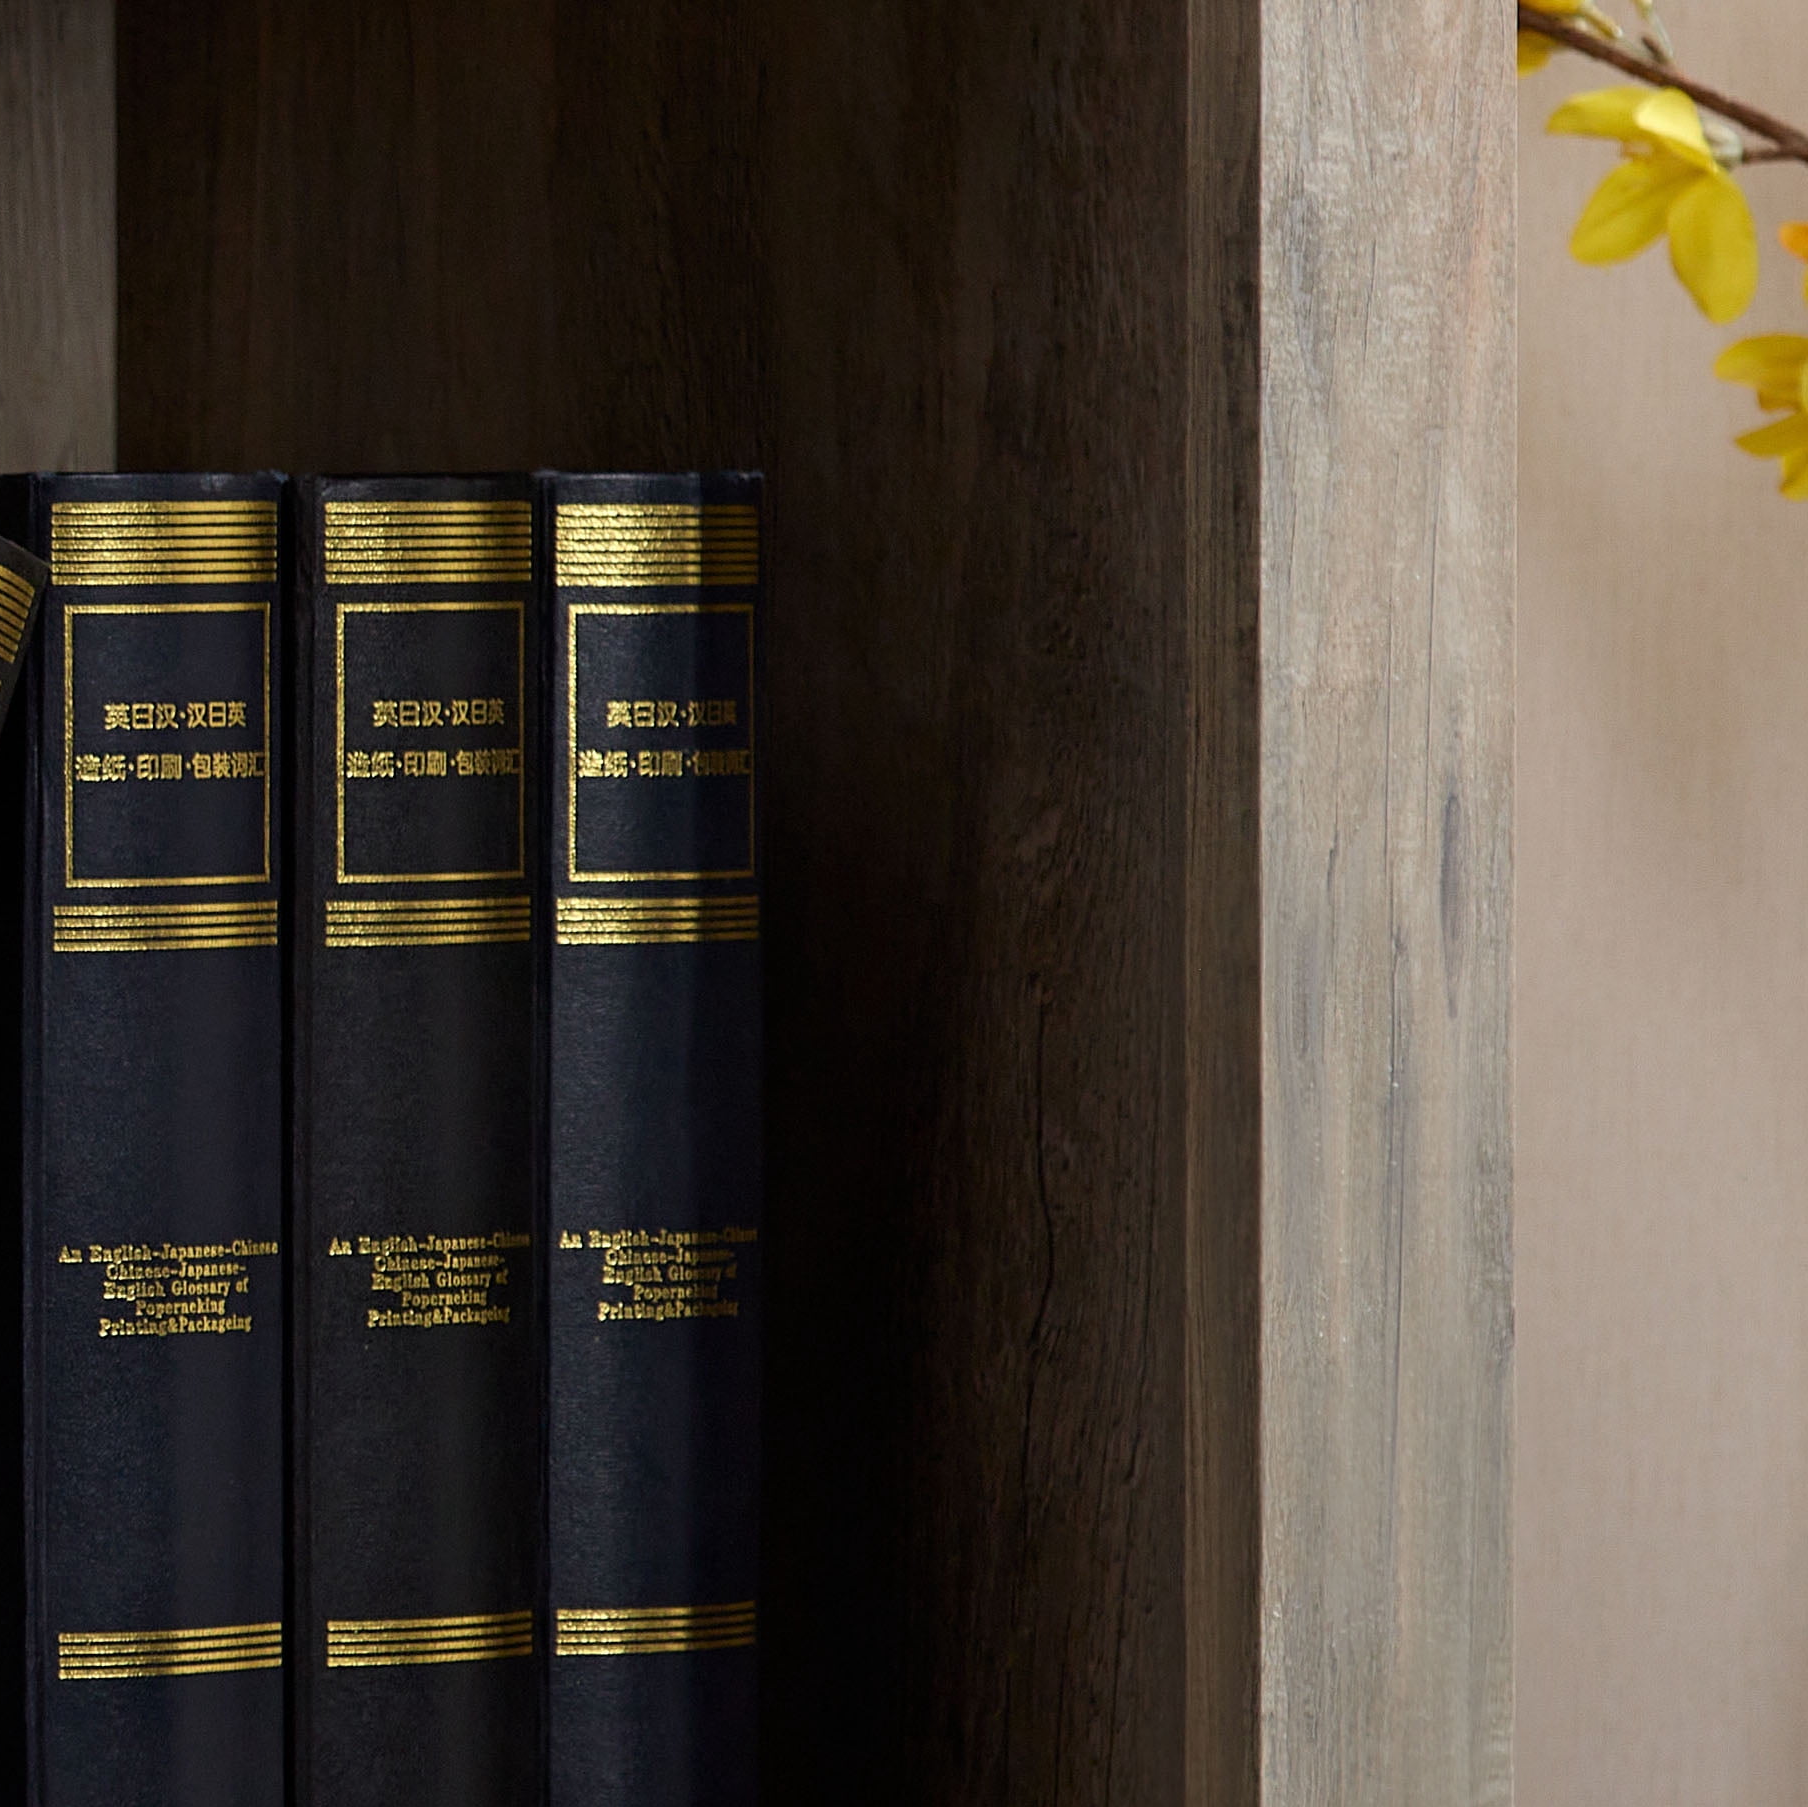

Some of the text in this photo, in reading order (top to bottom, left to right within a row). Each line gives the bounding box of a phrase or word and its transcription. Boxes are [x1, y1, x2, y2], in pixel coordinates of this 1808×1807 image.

[103, 700, 247, 731] 英日汉·汉日英
[372, 697, 505, 728] 英日汉·汉日英
[75, 750, 265, 782] 造纸·印刷·包装词汇
[328, 1235, 353, 1257] An
[558, 1228, 584, 1249] An
[58, 1238, 279, 1265] An English-Japanese-Chinese
[105, 1261, 247, 1281] Chinese-Japanese-
[370, 1271, 431, 1293] English
[435, 1271, 492, 1289] Glossary
[602, 1265, 664, 1287] English
[102, 1276, 250, 1301] English Glossary of
